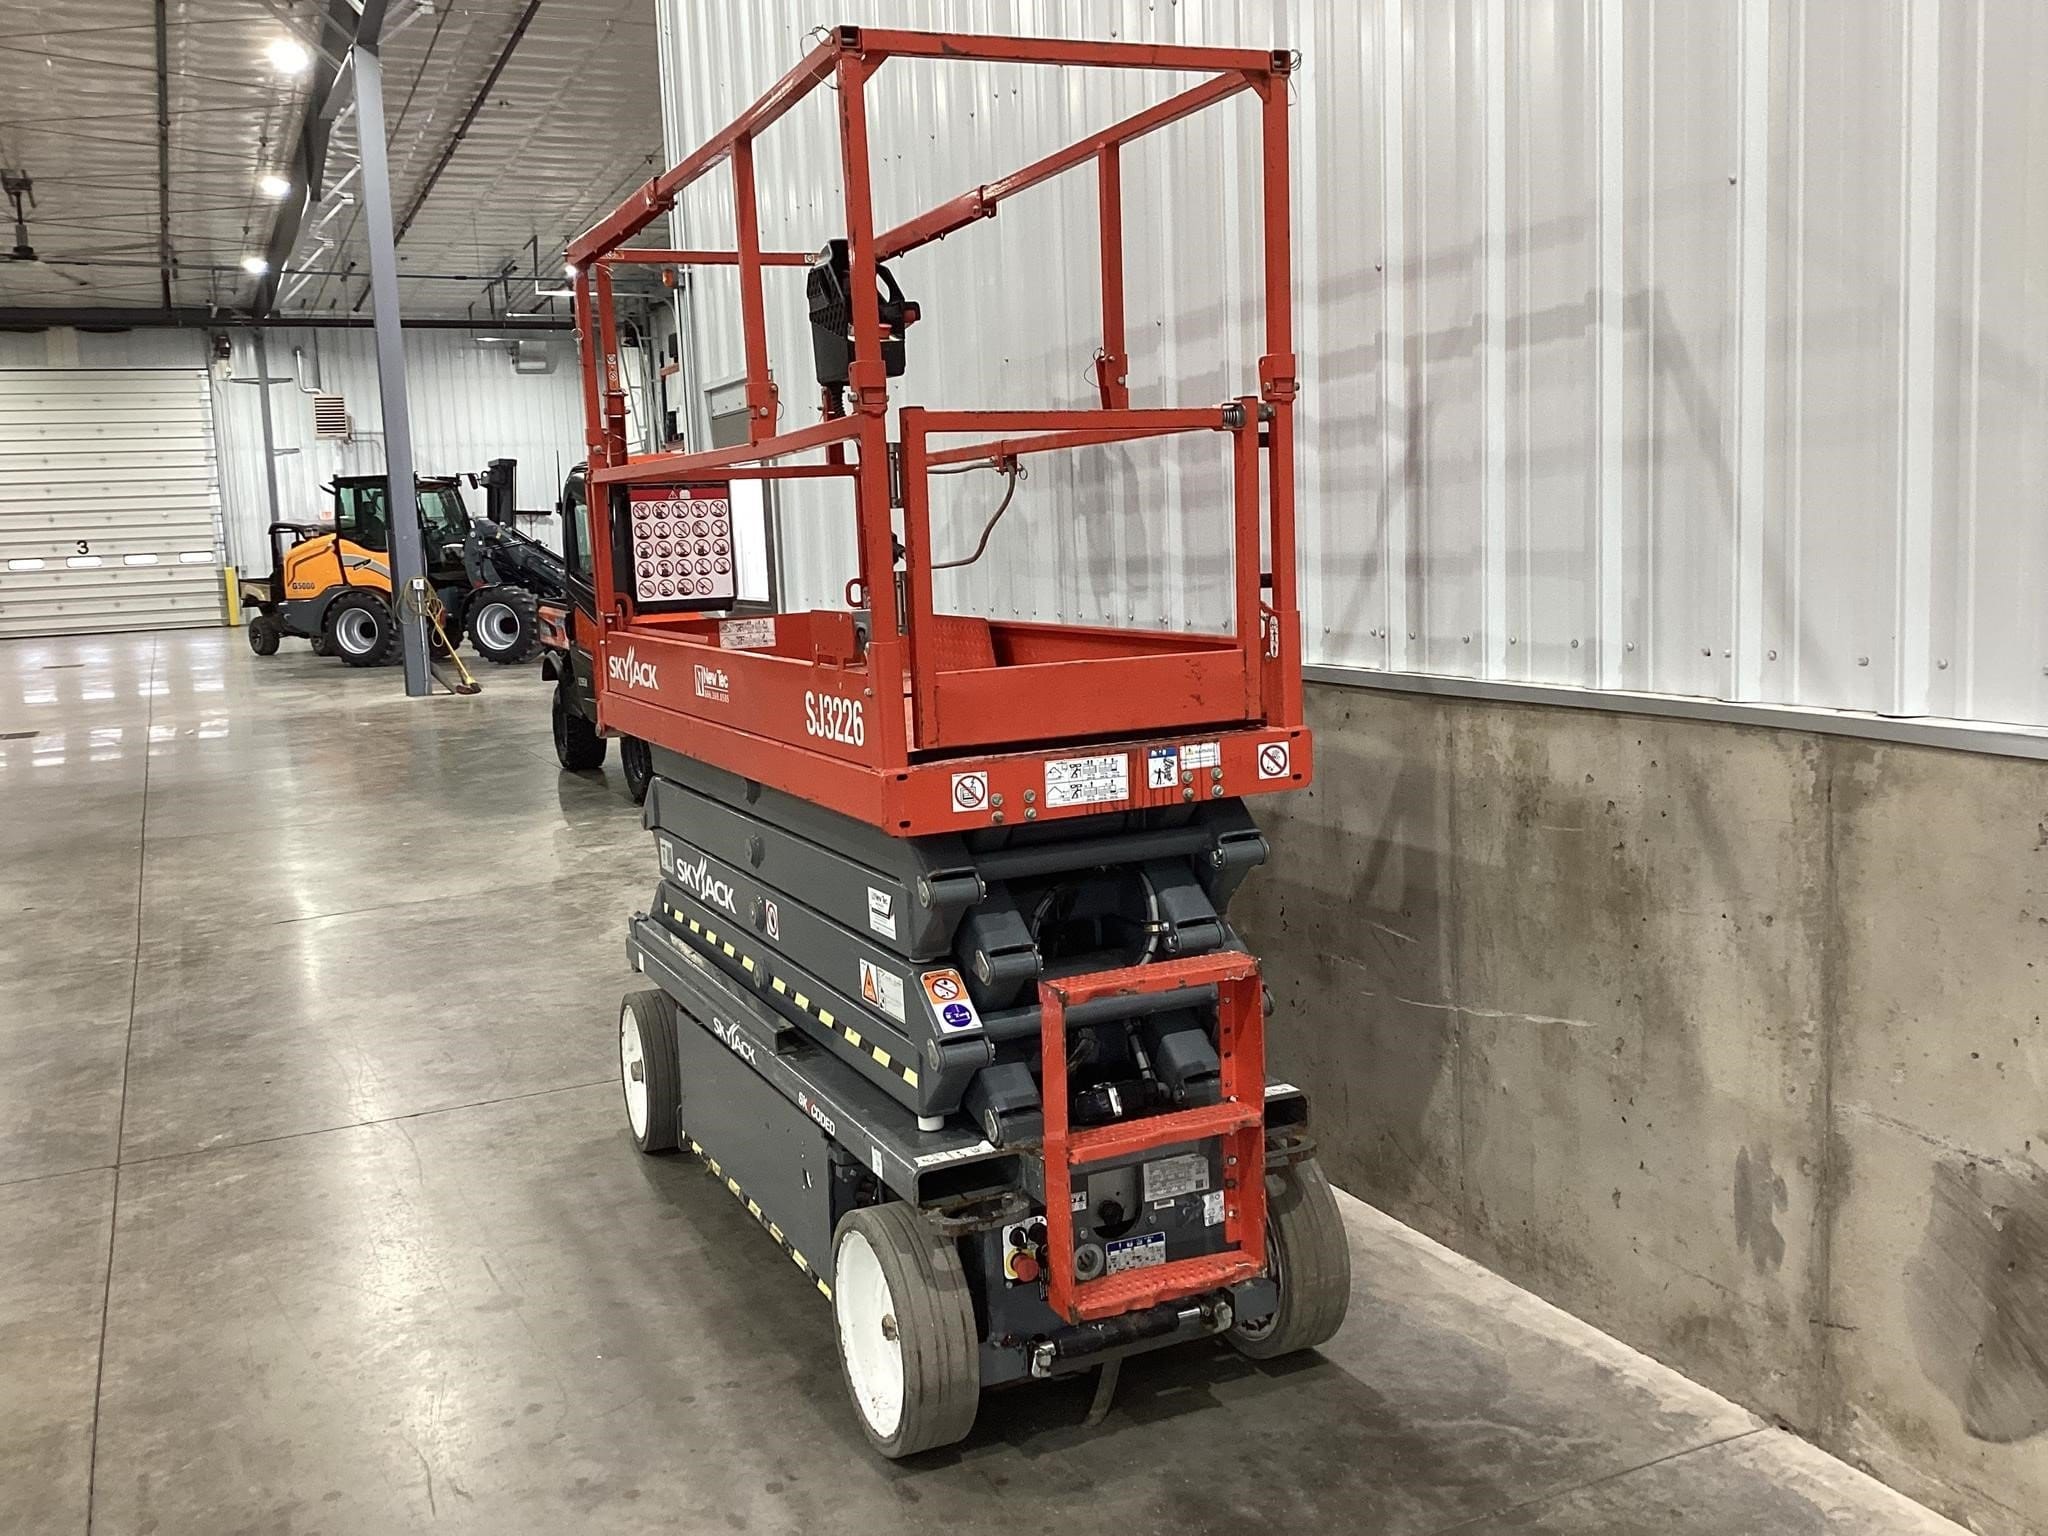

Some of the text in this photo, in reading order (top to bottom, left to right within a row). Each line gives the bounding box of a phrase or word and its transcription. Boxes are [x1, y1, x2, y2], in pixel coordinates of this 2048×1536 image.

[76, 540, 90, 555] 3
[292, 582, 316, 591] G5000
[608, 645, 659, 690] SKYJACK
[805, 690, 865, 747] SJ3226
[676, 855, 737, 915] SKYJACK
[713, 1017, 756, 1065] SKYJACK
